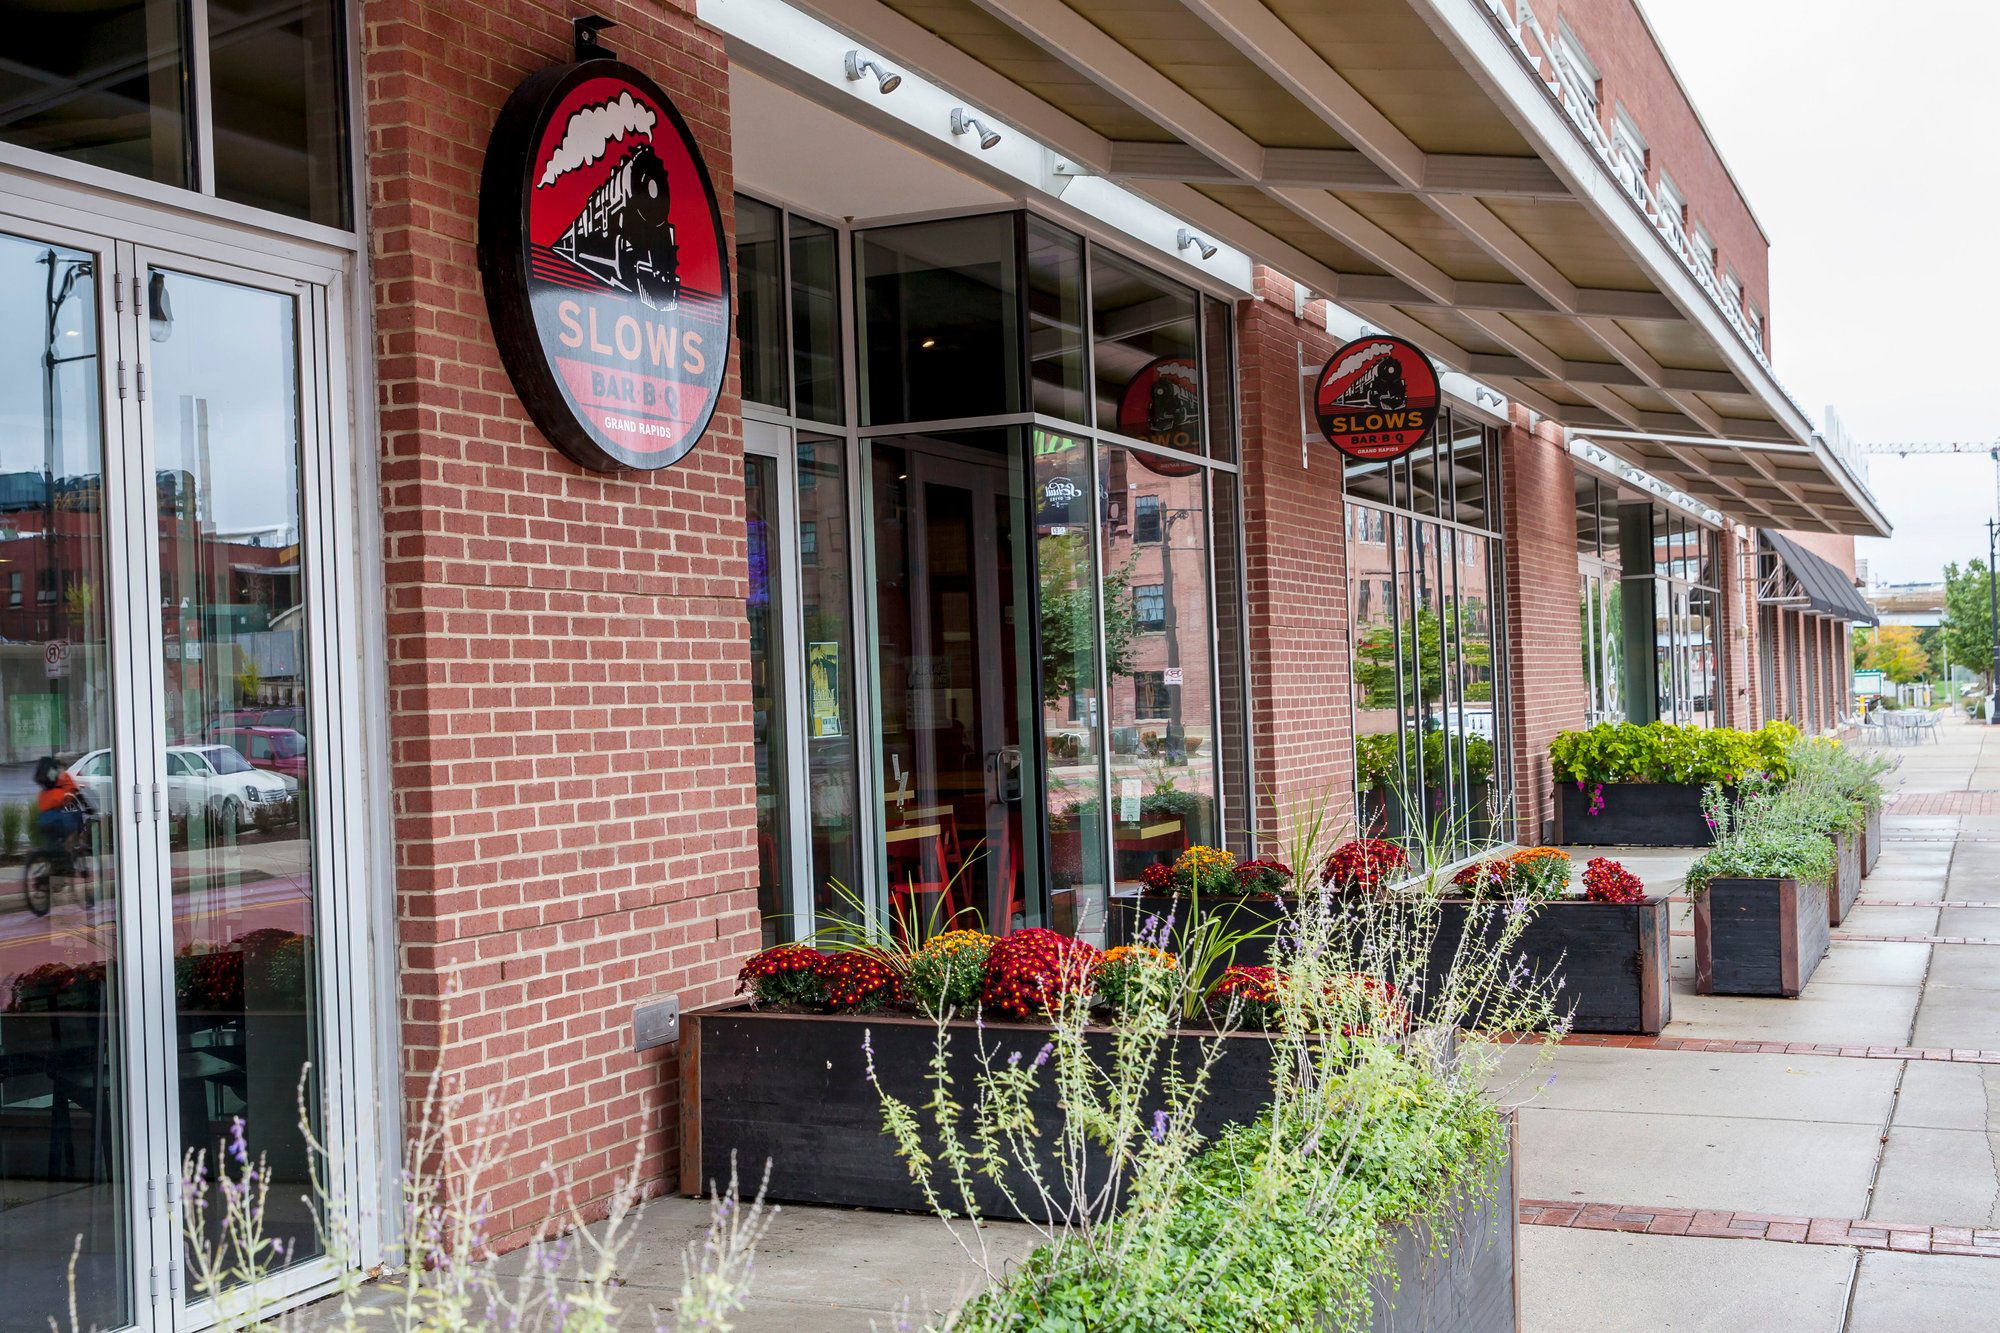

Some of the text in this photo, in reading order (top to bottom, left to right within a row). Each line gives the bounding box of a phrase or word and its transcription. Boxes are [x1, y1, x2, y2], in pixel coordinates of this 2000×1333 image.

[558, 300, 705, 375] SLOWS
[604, 416, 671, 439] GRAND RAPIDS
[1332, 411, 1423, 433] SLOWS
